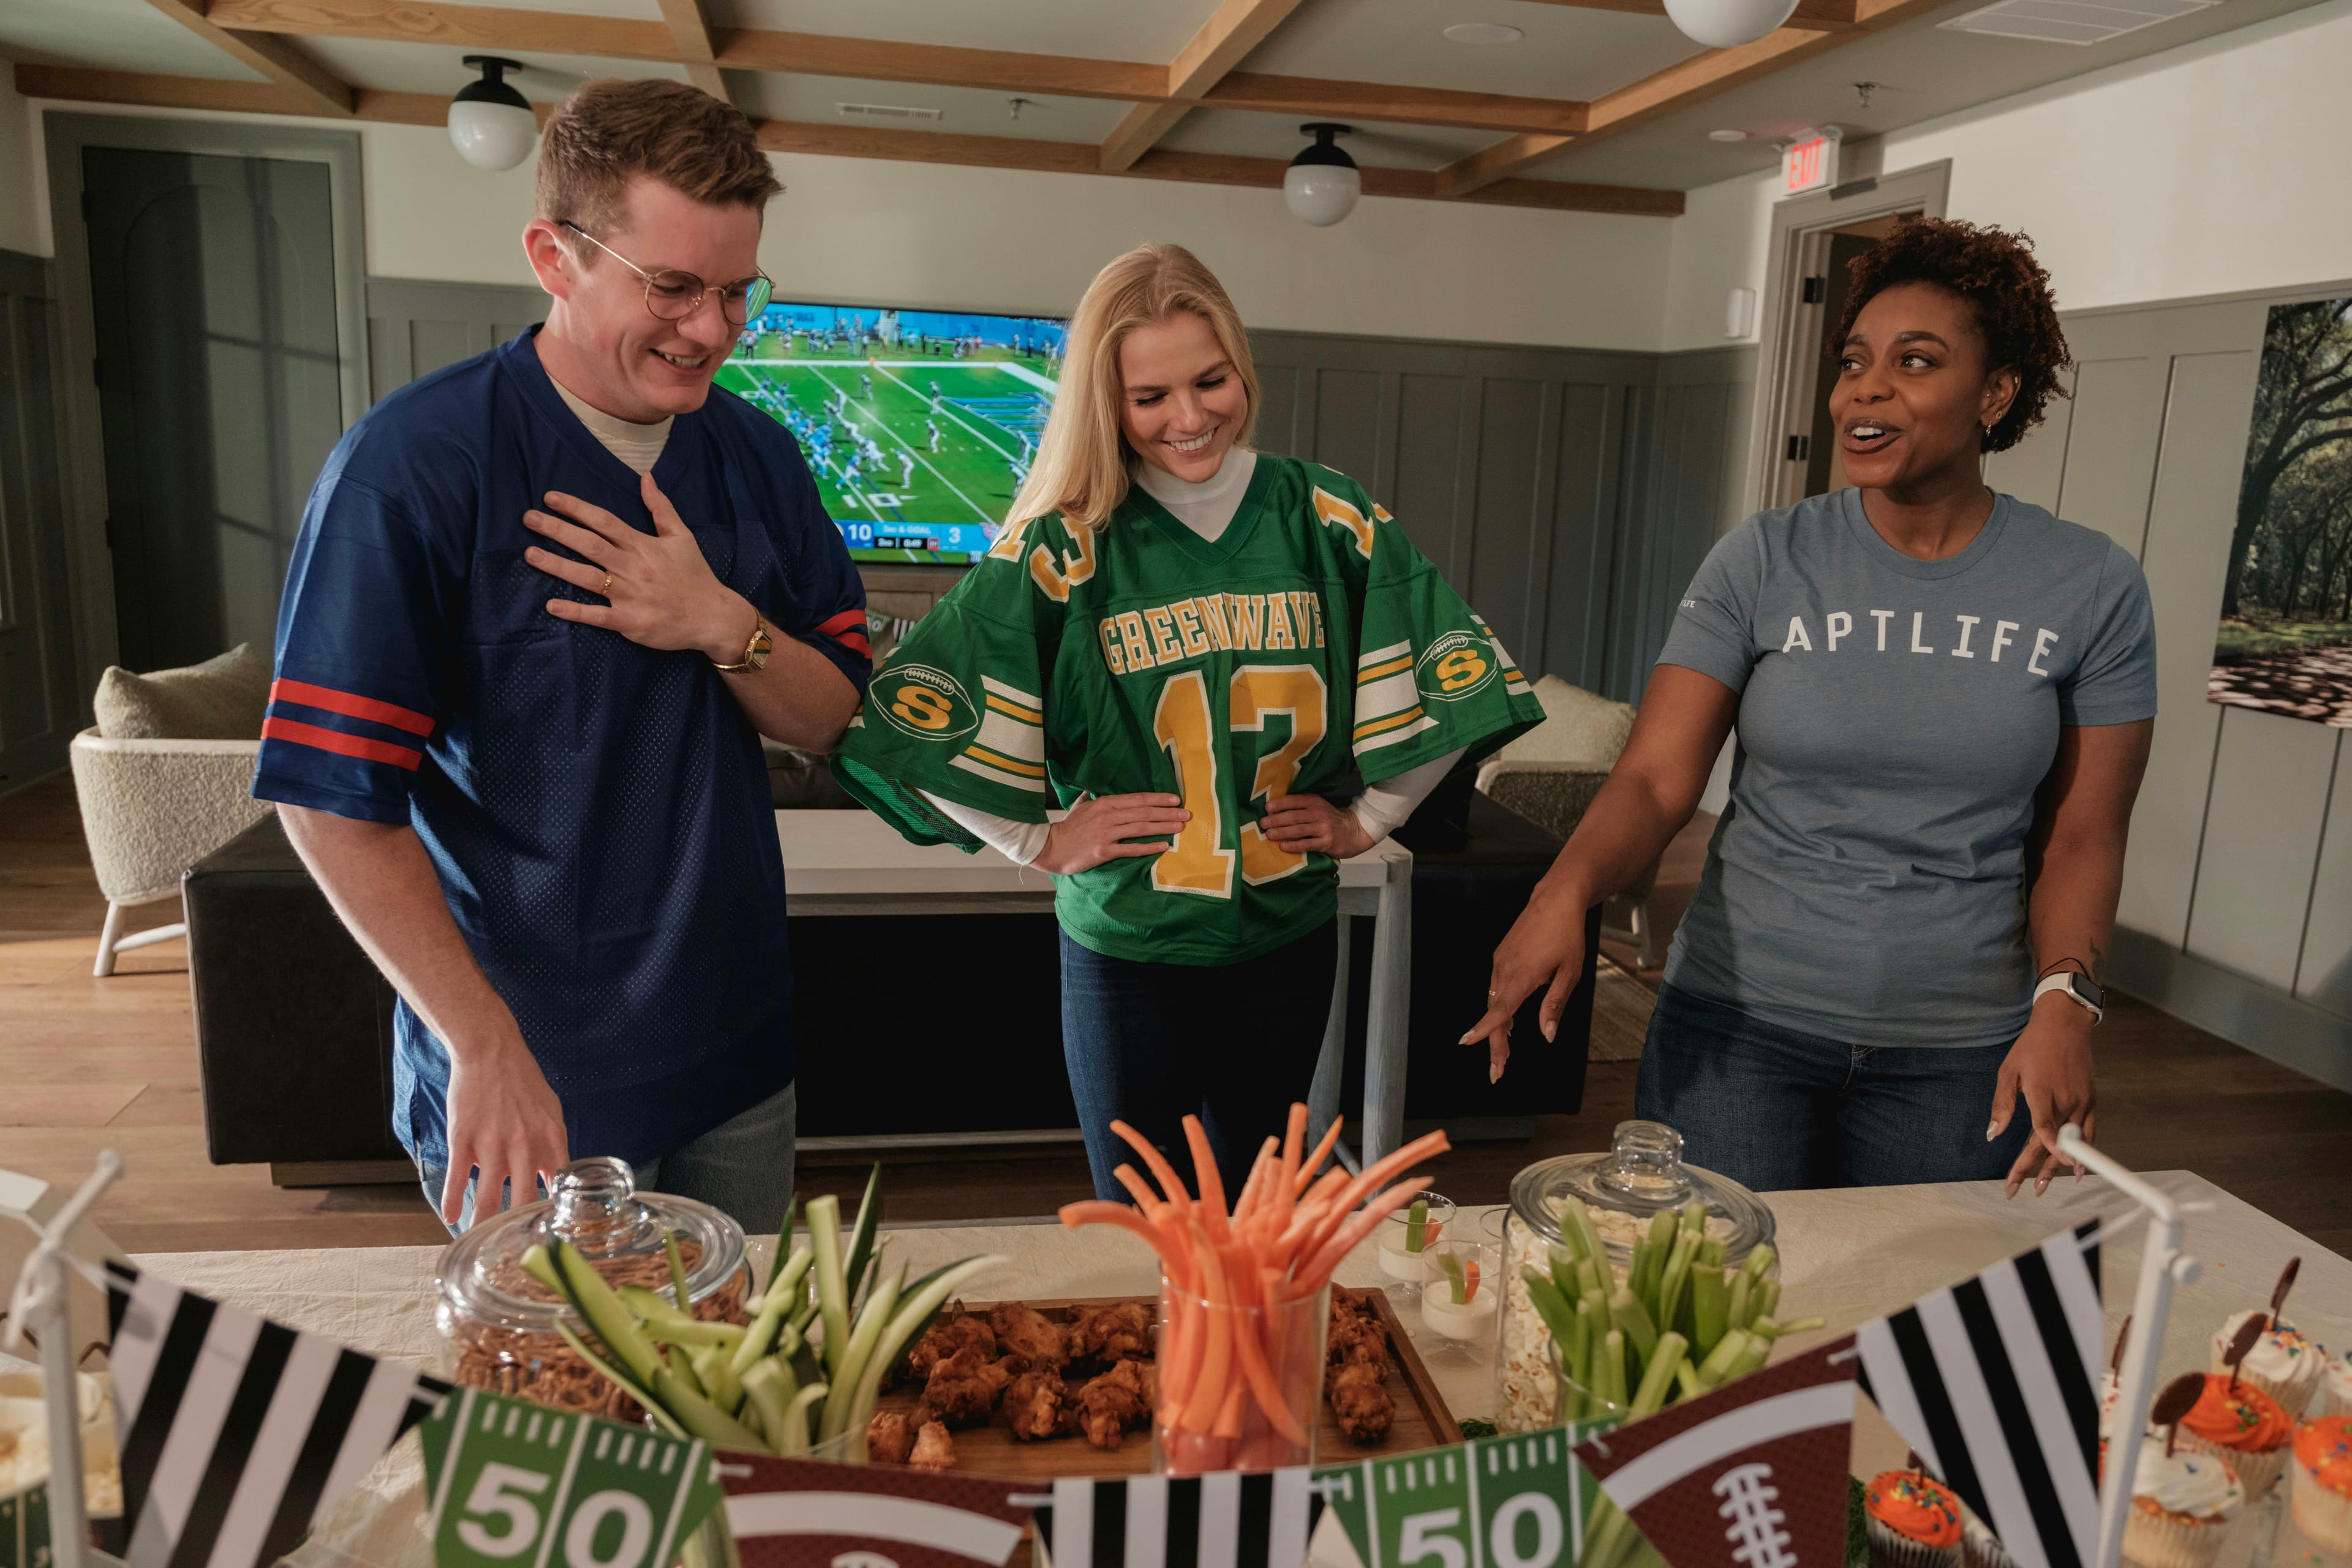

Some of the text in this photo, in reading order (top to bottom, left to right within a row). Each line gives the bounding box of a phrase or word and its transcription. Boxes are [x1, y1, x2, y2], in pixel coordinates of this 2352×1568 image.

[1788, 137, 1823, 189] EXIT
[848, 524, 872, 541] 10
[907, 526, 931, 535] GOAL
[948, 527, 960, 543] 3
[1099, 591, 1325, 675] GREENWAVE
[1782, 609, 2059, 677] APTLIFE
[1436, 649, 1487, 691] S
[892, 685, 952, 729] S
[1151, 664, 1327, 899] 13
[457, 1460, 655, 1568] 50
[1398, 1491, 1564, 1568] 50
